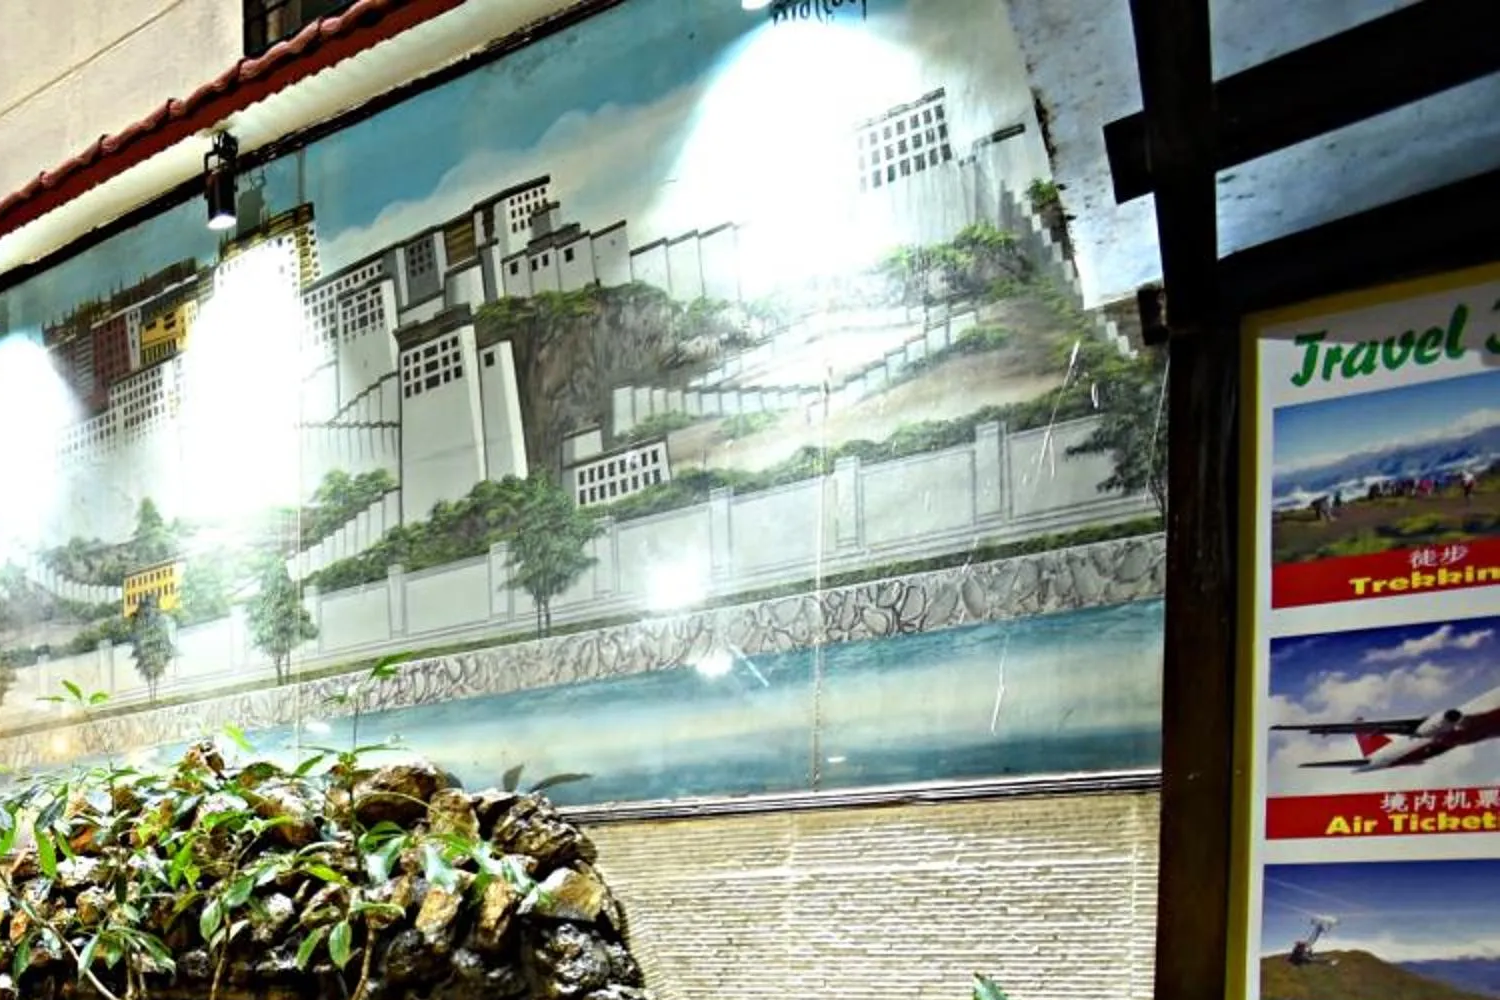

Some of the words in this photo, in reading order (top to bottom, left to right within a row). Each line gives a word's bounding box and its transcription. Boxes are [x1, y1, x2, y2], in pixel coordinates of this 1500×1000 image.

[1290, 303, 1470, 387] Travel
[1410, 544, 1469, 569] 徒步
[1325, 815, 1378, 835] Air
[1388, 811, 1500, 833] Ticket
